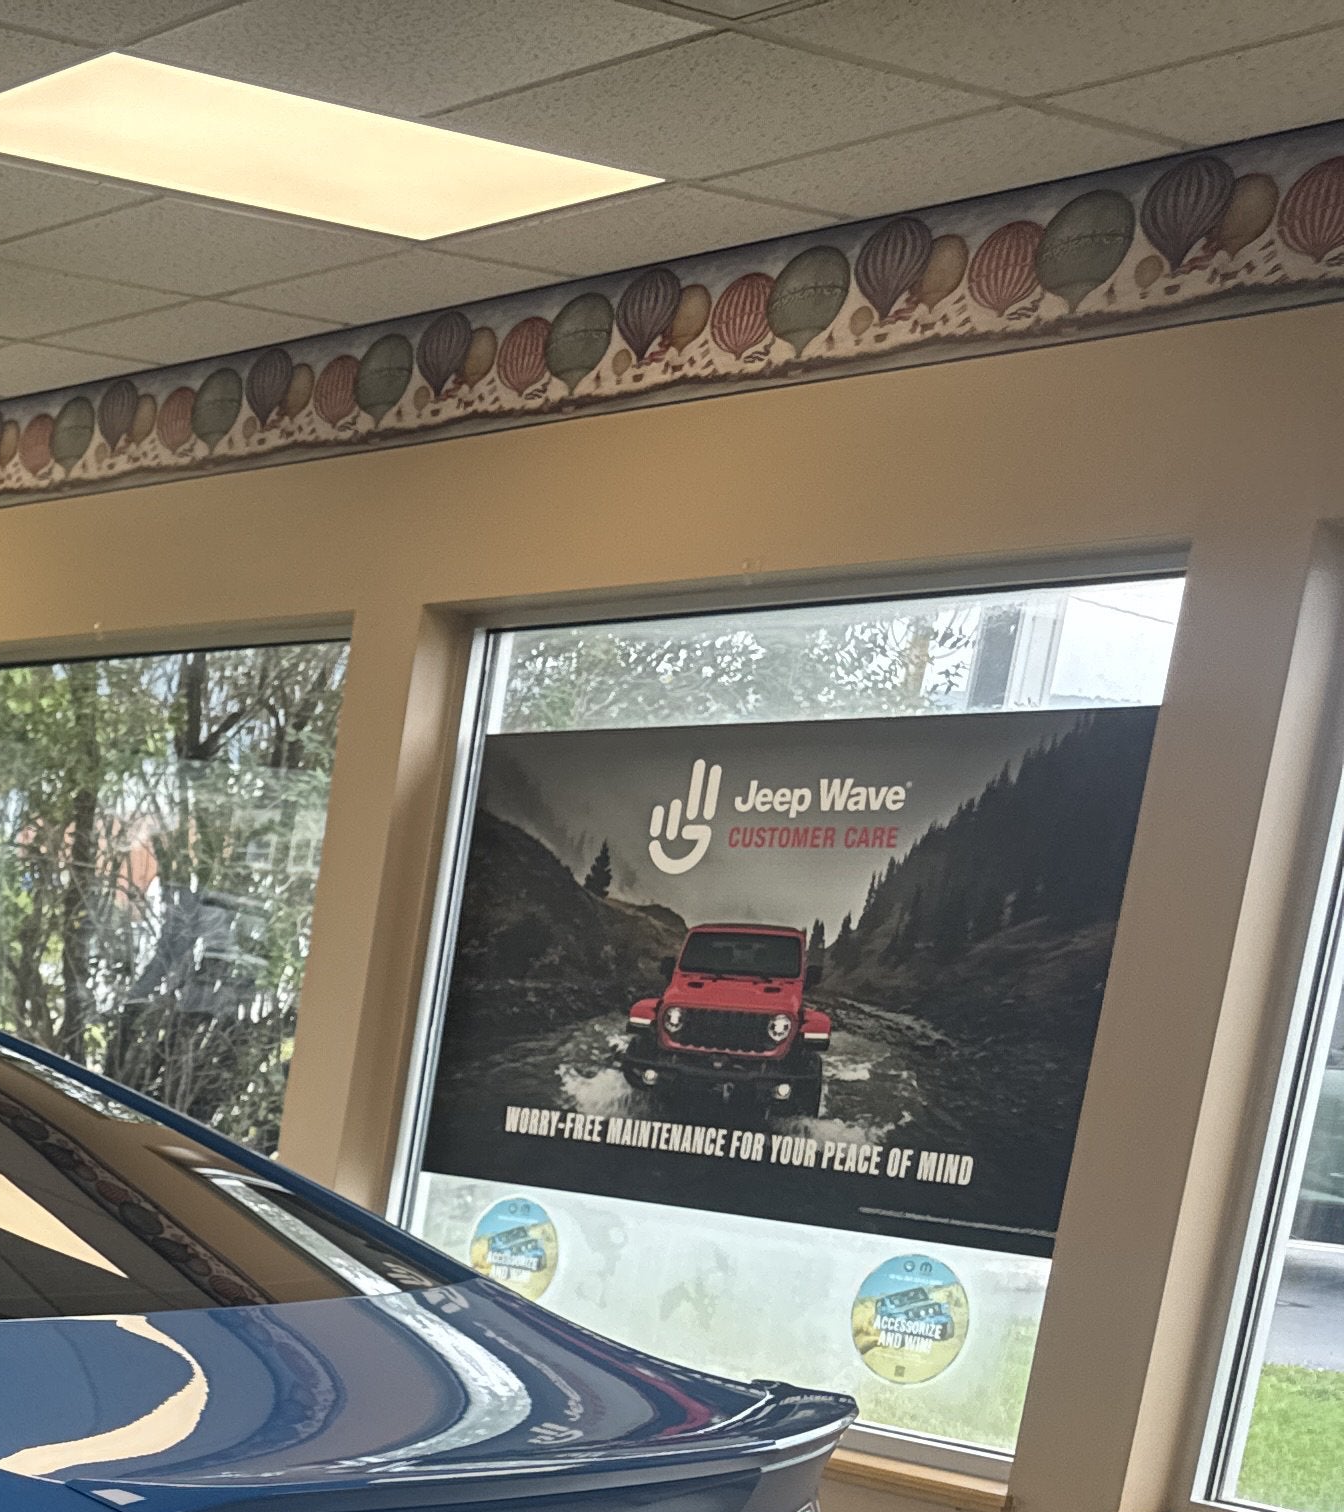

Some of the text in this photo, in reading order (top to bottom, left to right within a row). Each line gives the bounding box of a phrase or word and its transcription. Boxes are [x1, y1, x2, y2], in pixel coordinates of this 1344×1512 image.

[734, 780, 812, 818] Jeep
[728, 826, 900, 849] CUSTOMER CARE
[504, 1105, 974, 1186] WORRY-FREE MAINTENANCE FOR YOUR PEACE OF MIND
[873, 1314, 943, 1340] ACCESSORIZE
[877, 1330, 904, 1349] AND
